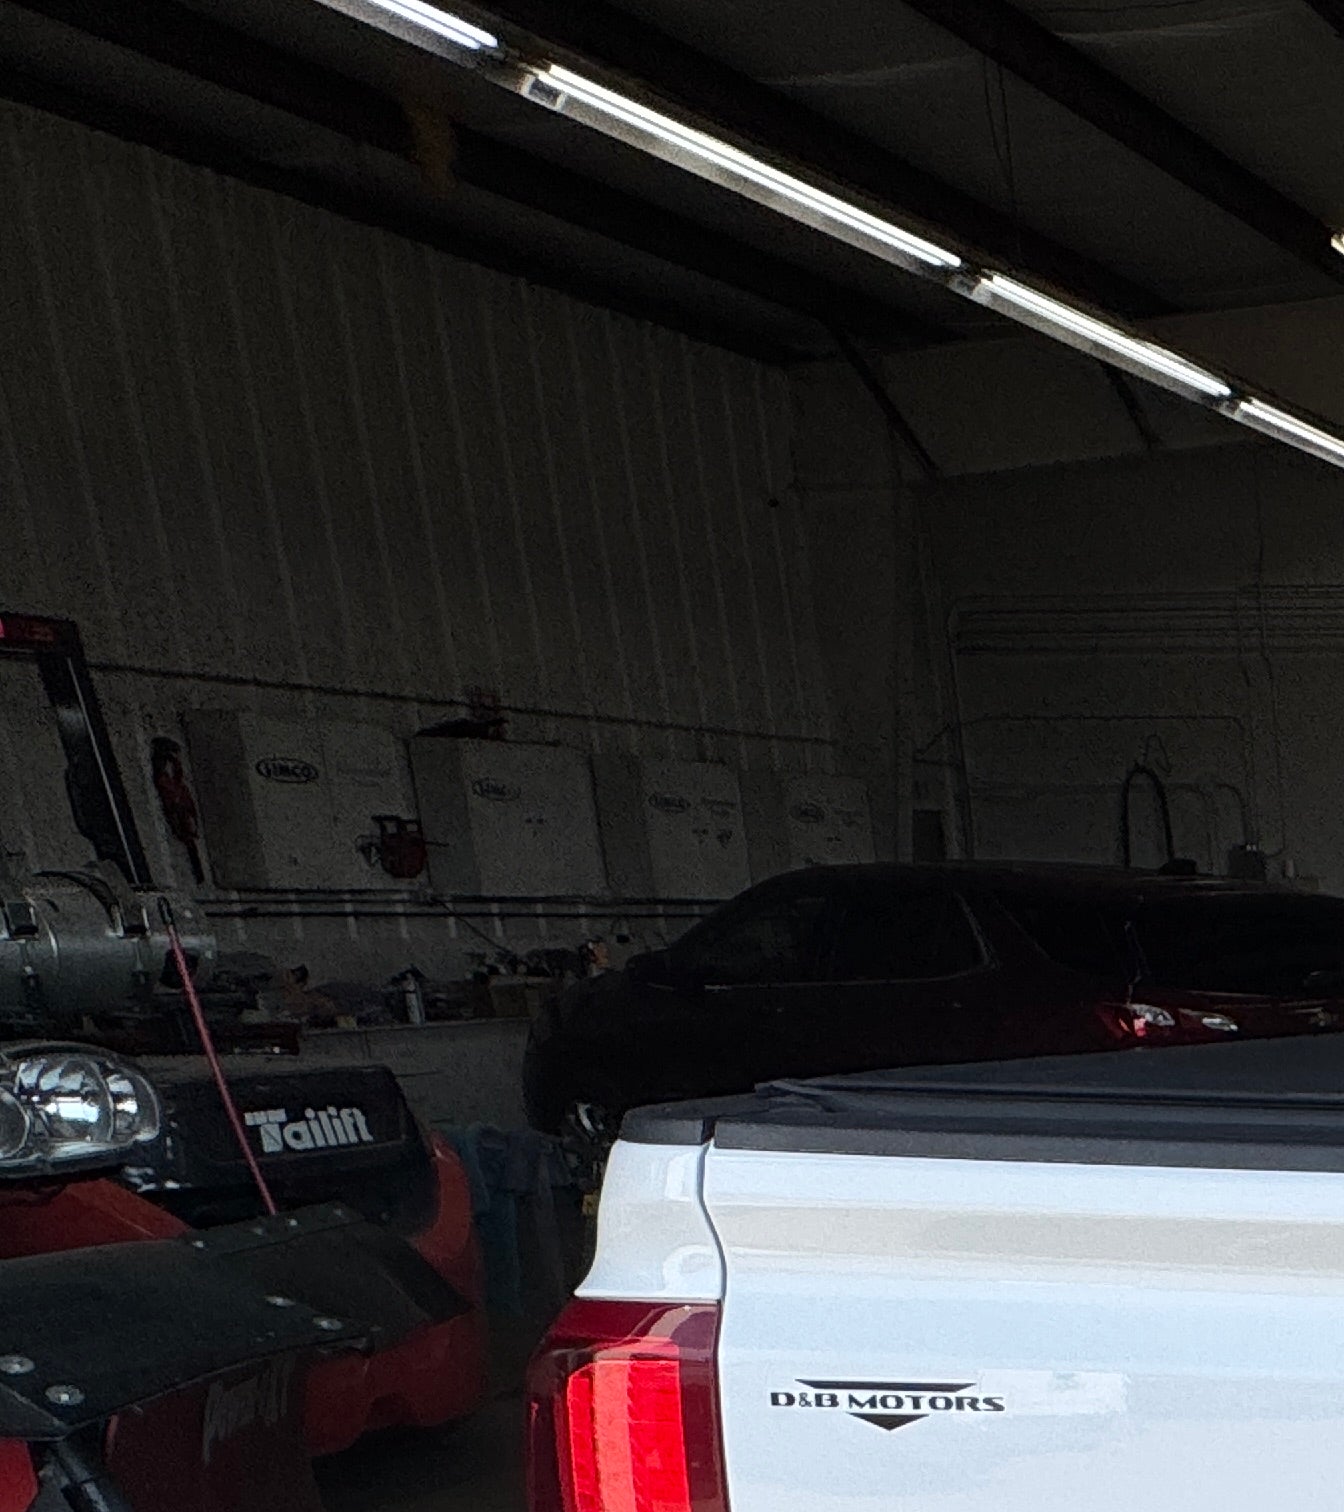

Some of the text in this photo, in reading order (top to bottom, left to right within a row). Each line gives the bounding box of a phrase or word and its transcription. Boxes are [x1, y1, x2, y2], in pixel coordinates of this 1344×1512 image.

[244, 1104, 374, 1153] Tailift
[770, 1392, 1005, 1412] D&B MOTORS
